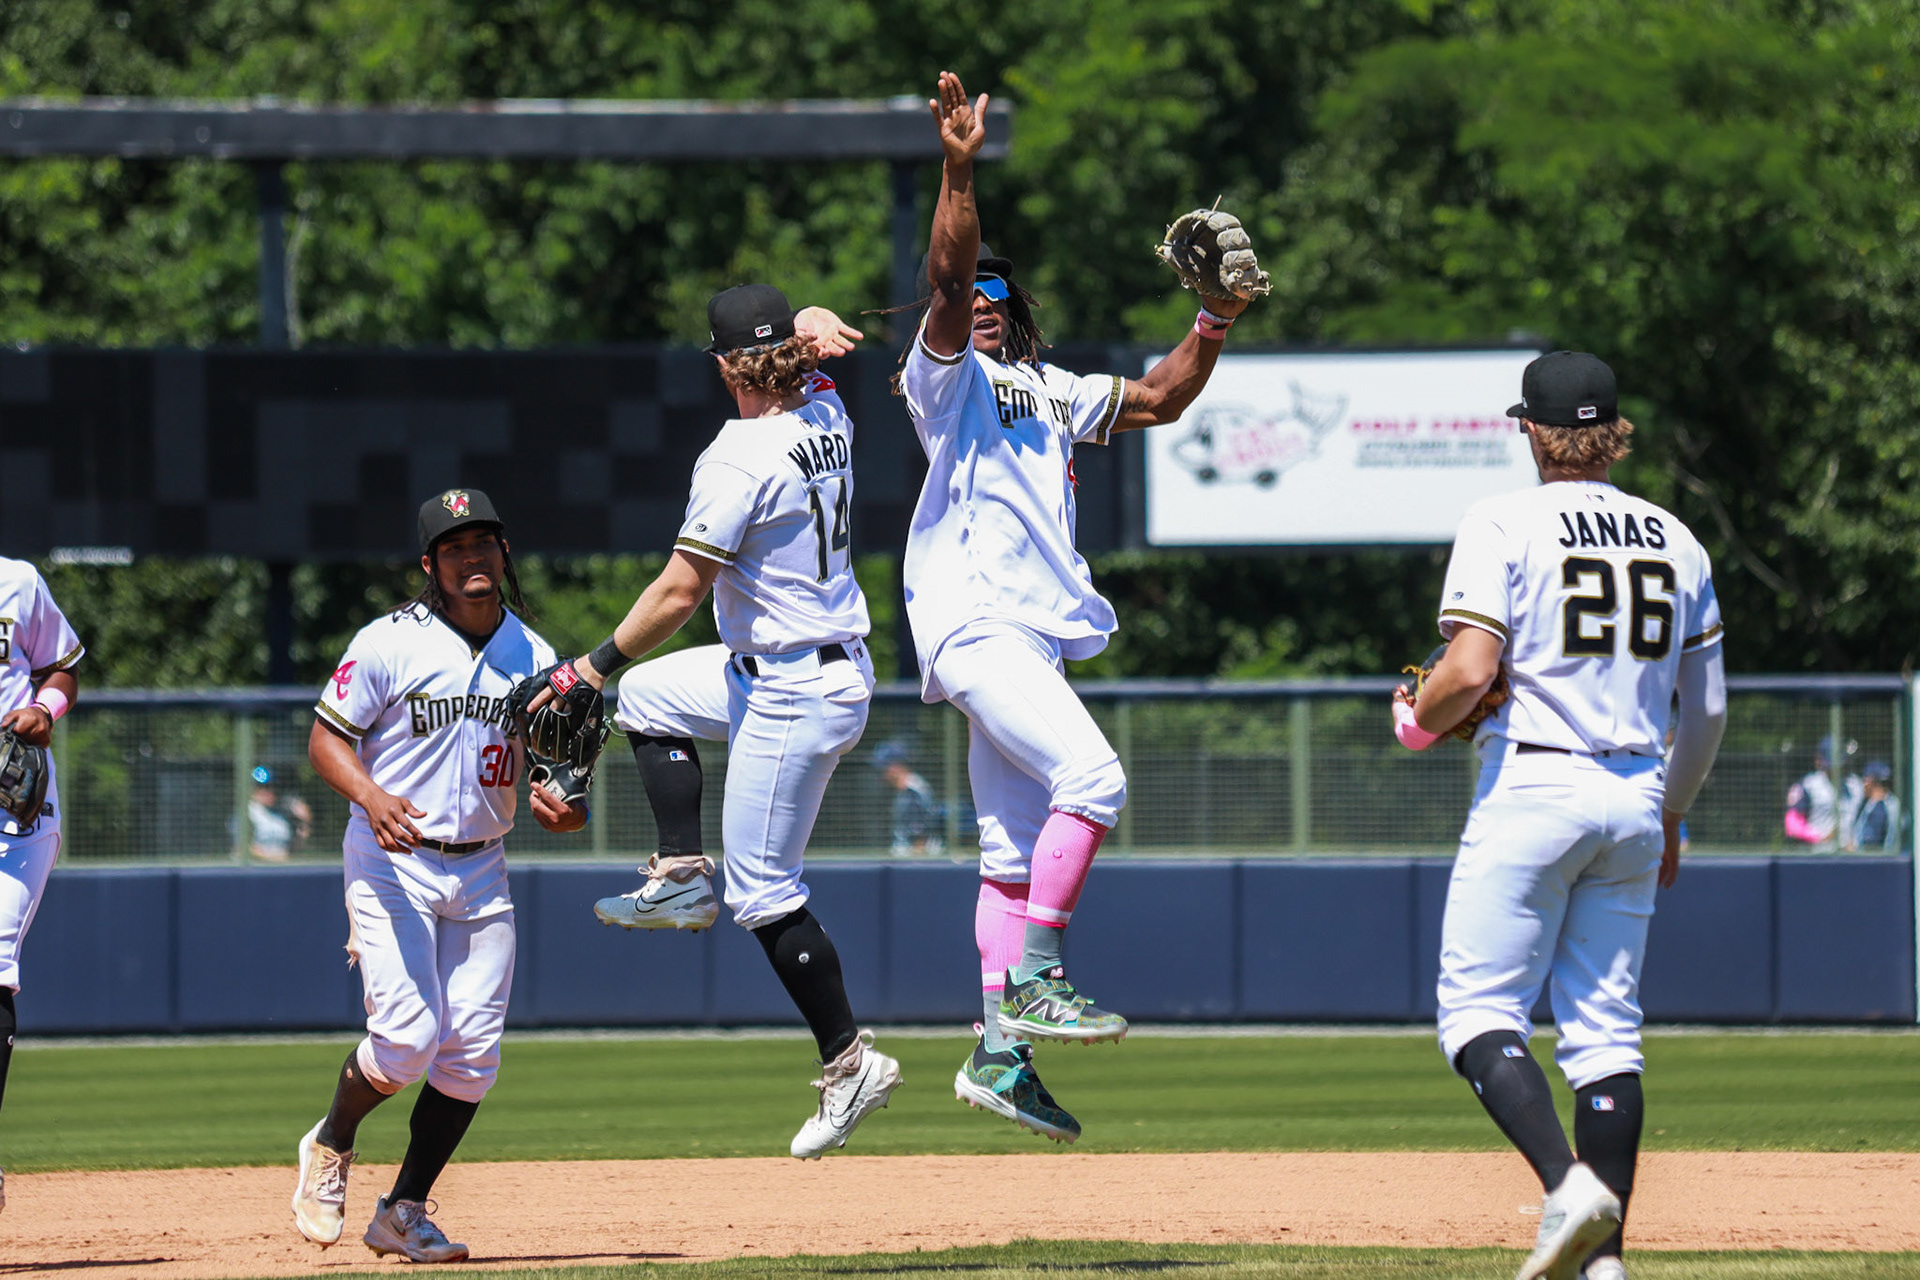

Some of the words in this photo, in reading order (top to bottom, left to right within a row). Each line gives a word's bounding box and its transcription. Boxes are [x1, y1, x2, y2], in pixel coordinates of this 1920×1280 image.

[787, 433, 848, 482] WARD
[810, 476, 849, 582] 14
[1558, 511, 1667, 550] JANAS
[1561, 555, 1677, 662] 26
[404, 691, 519, 740] EMPERO
[479, 744, 515, 788] 30
